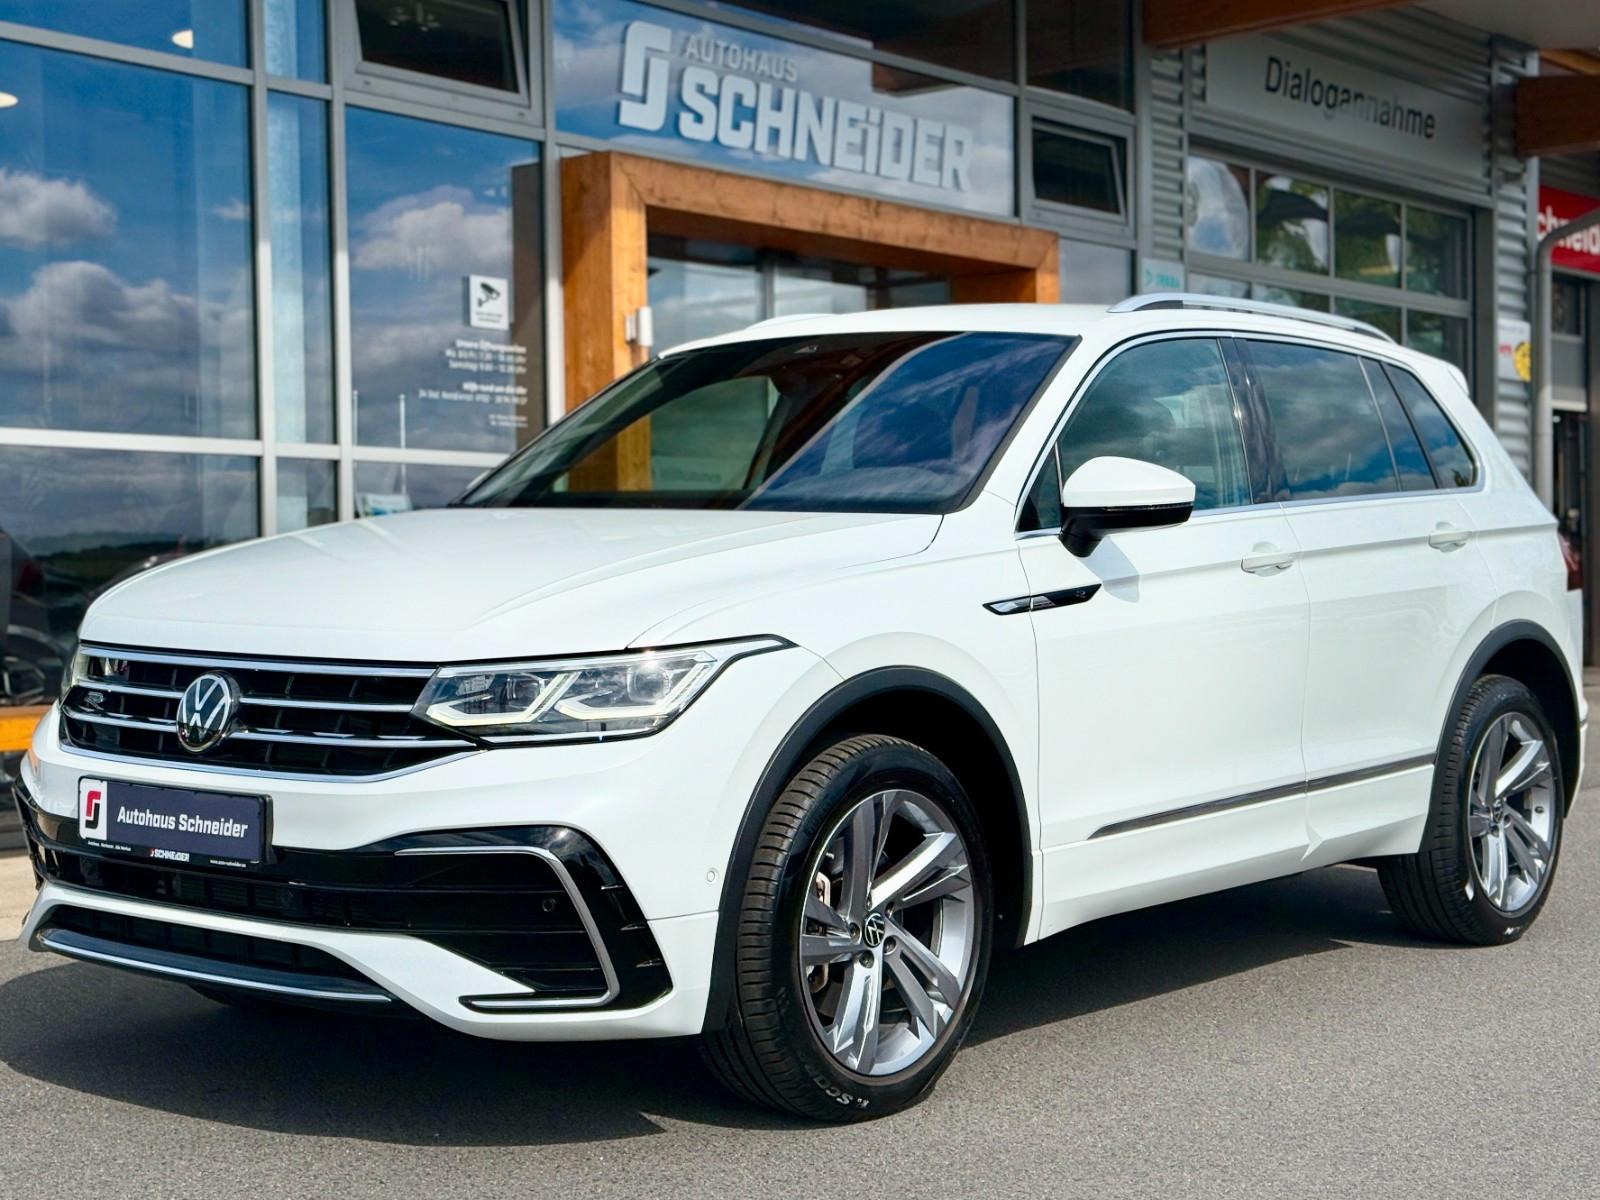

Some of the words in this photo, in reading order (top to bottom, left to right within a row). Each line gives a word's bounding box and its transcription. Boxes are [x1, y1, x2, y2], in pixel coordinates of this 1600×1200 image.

[684, 34, 798, 82] AUTOHAUS
[1265, 56, 1436, 139] Dialogannahme
[116, 805, 176, 831] Autohaus
[178, 814, 248, 838] Schneider
